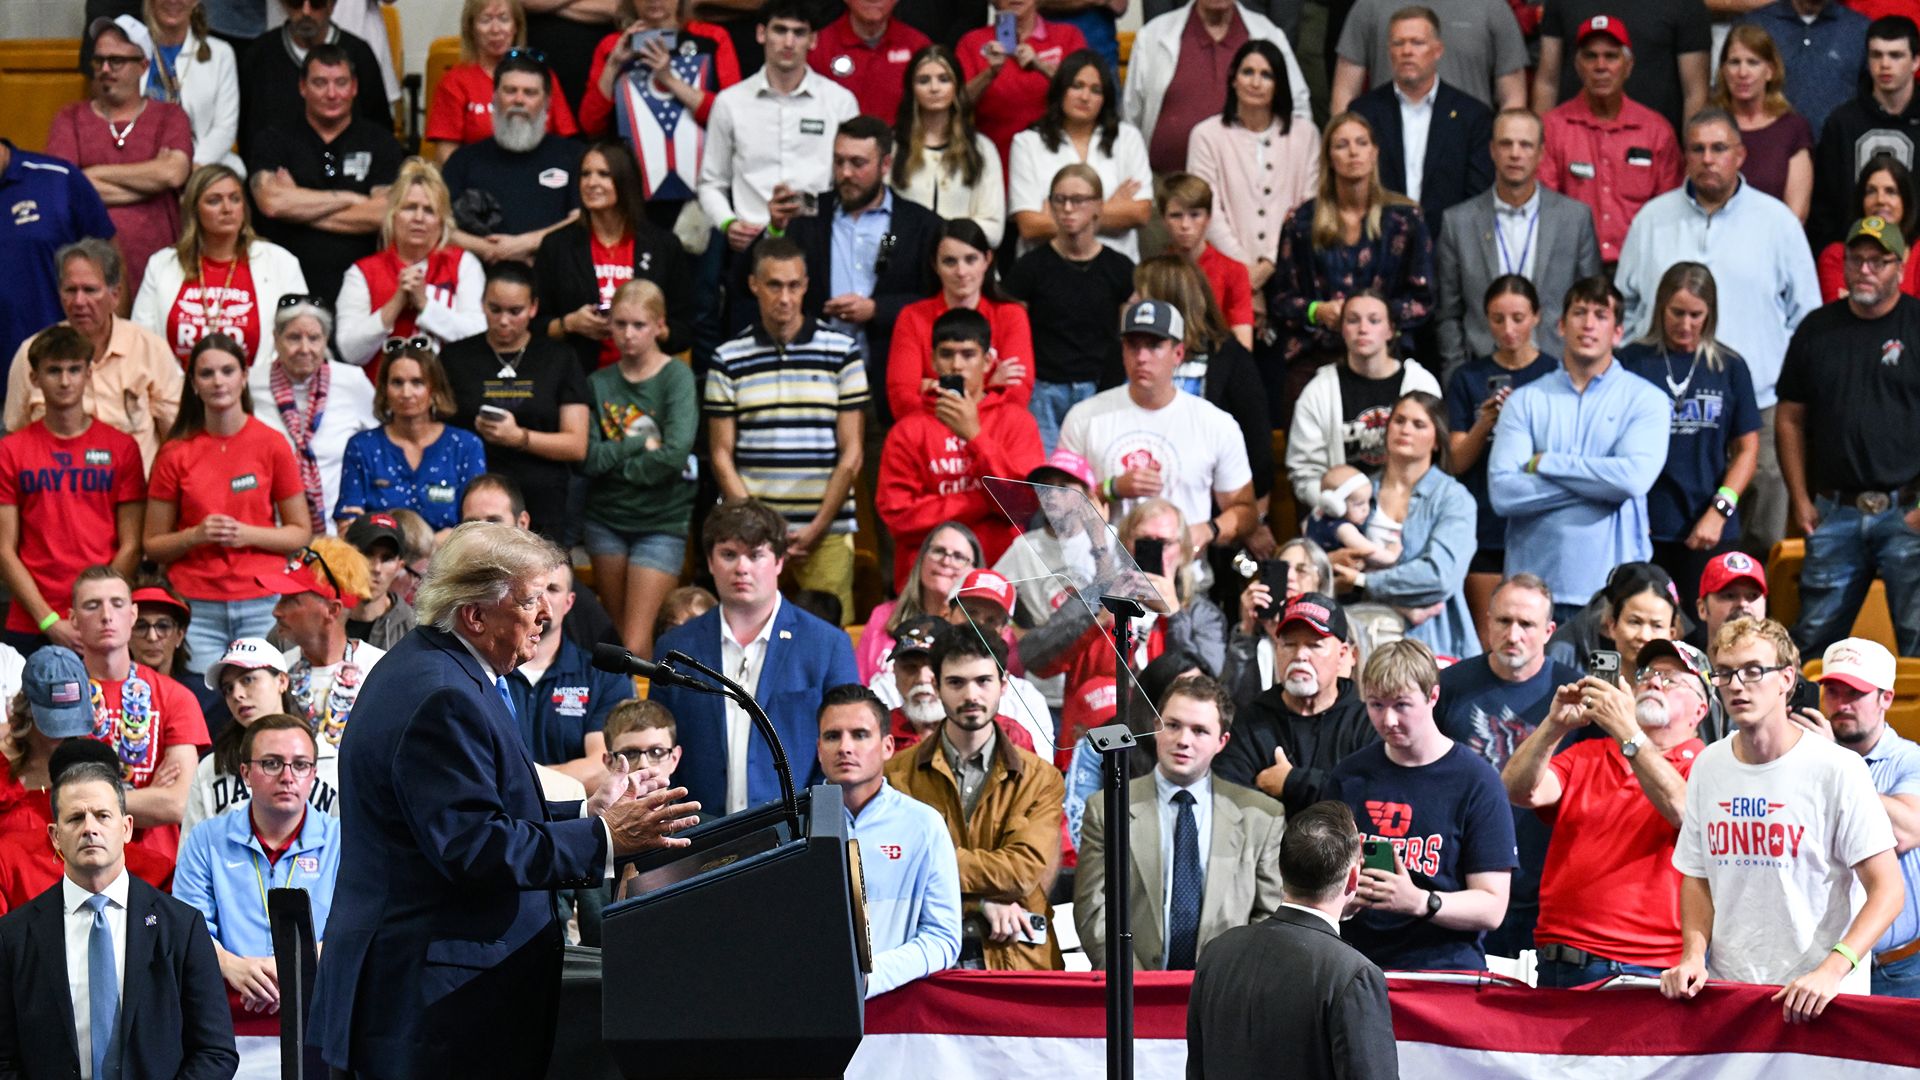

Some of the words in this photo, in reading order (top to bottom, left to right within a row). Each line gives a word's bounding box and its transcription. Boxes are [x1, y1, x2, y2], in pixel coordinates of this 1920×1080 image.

[183, 286, 250, 303] AVIATORS
[18, 466, 114, 495] DAYTON
[1732, 797, 1766, 817] ERIC
[1707, 820, 1805, 858] CONROY
